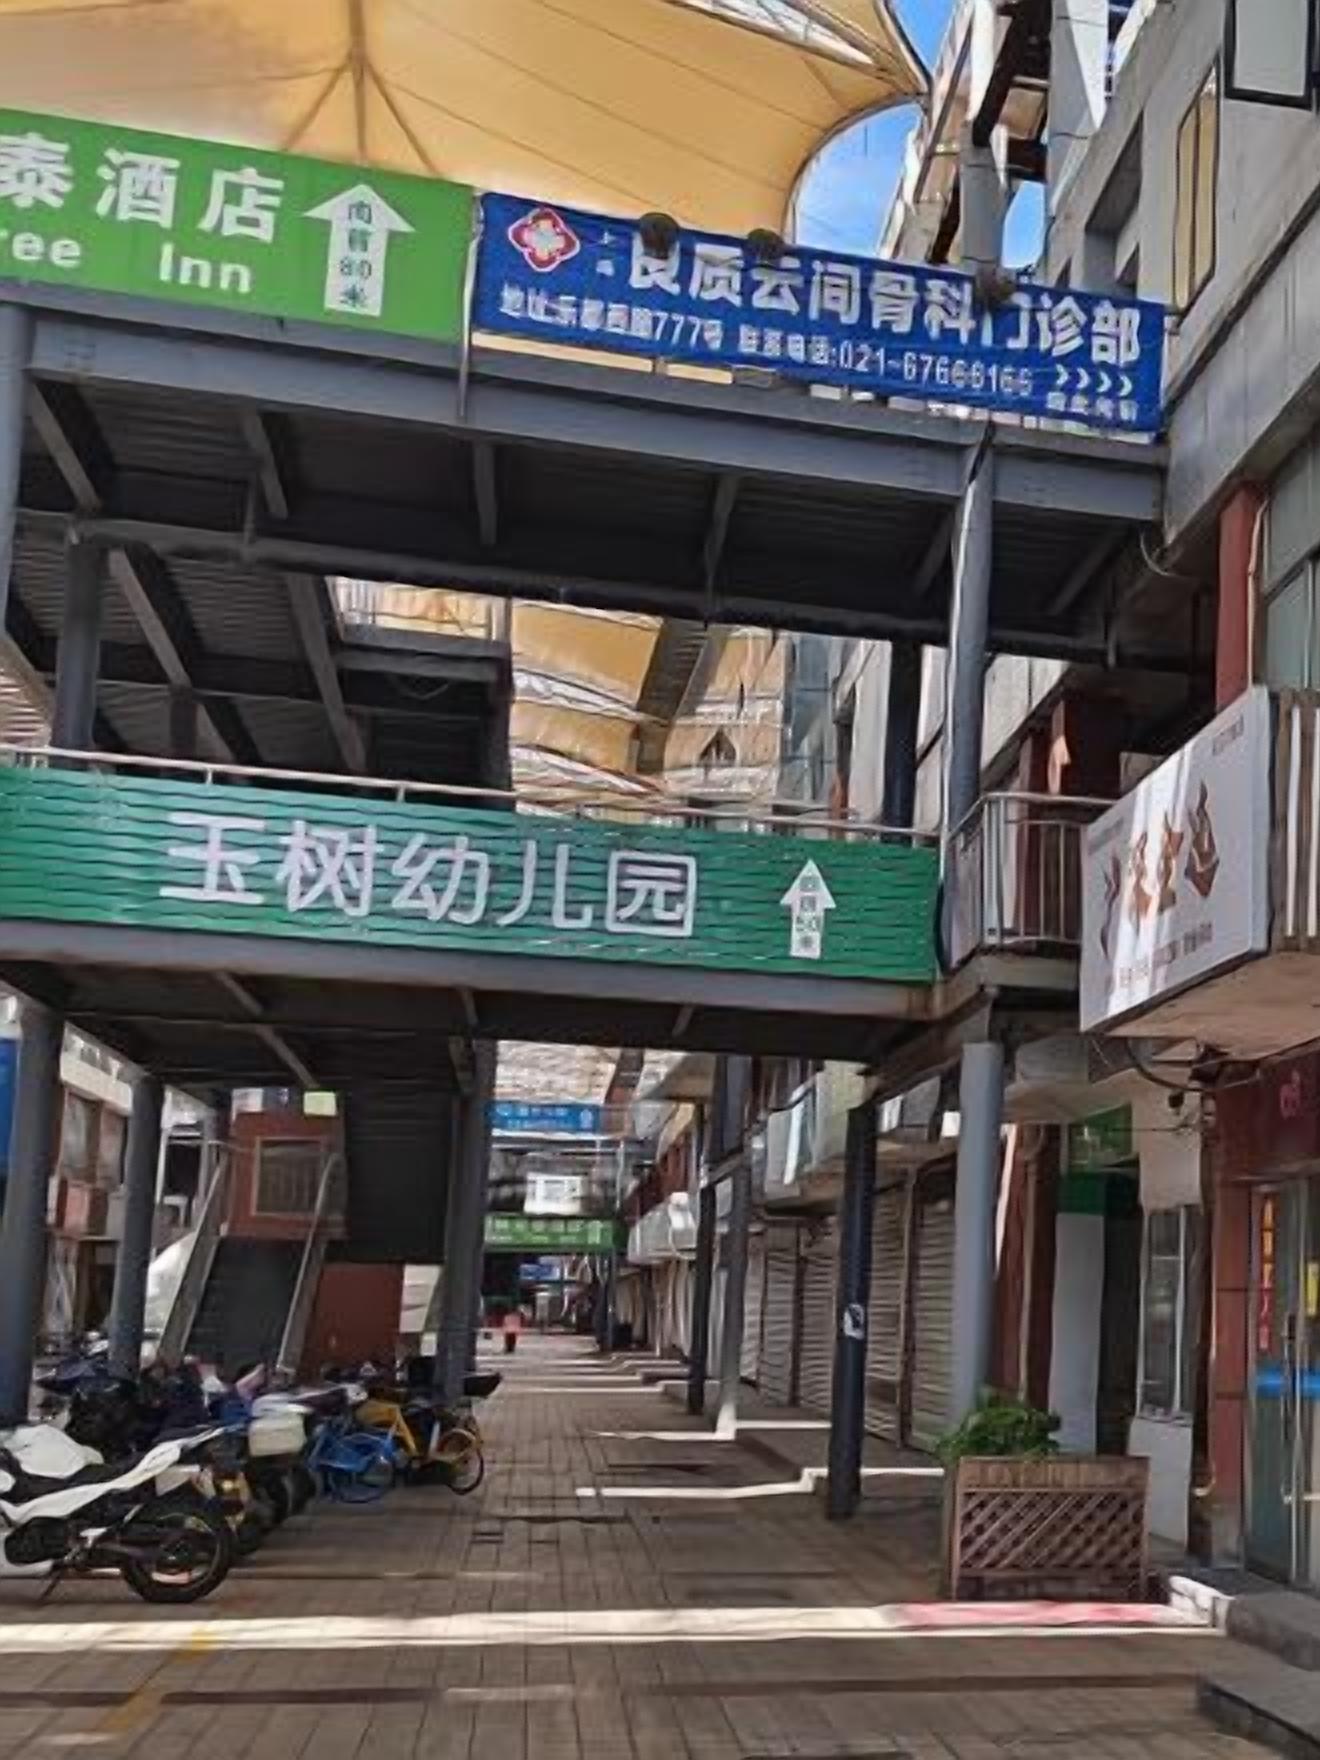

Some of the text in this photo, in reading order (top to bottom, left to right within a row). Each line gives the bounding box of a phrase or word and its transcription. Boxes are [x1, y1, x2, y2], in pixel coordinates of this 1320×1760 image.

[0, 132, 284, 244] 泰酒店
[159, 243, 252, 294] Inn
[159, 810, 697, 938] 玉树幼儿园
